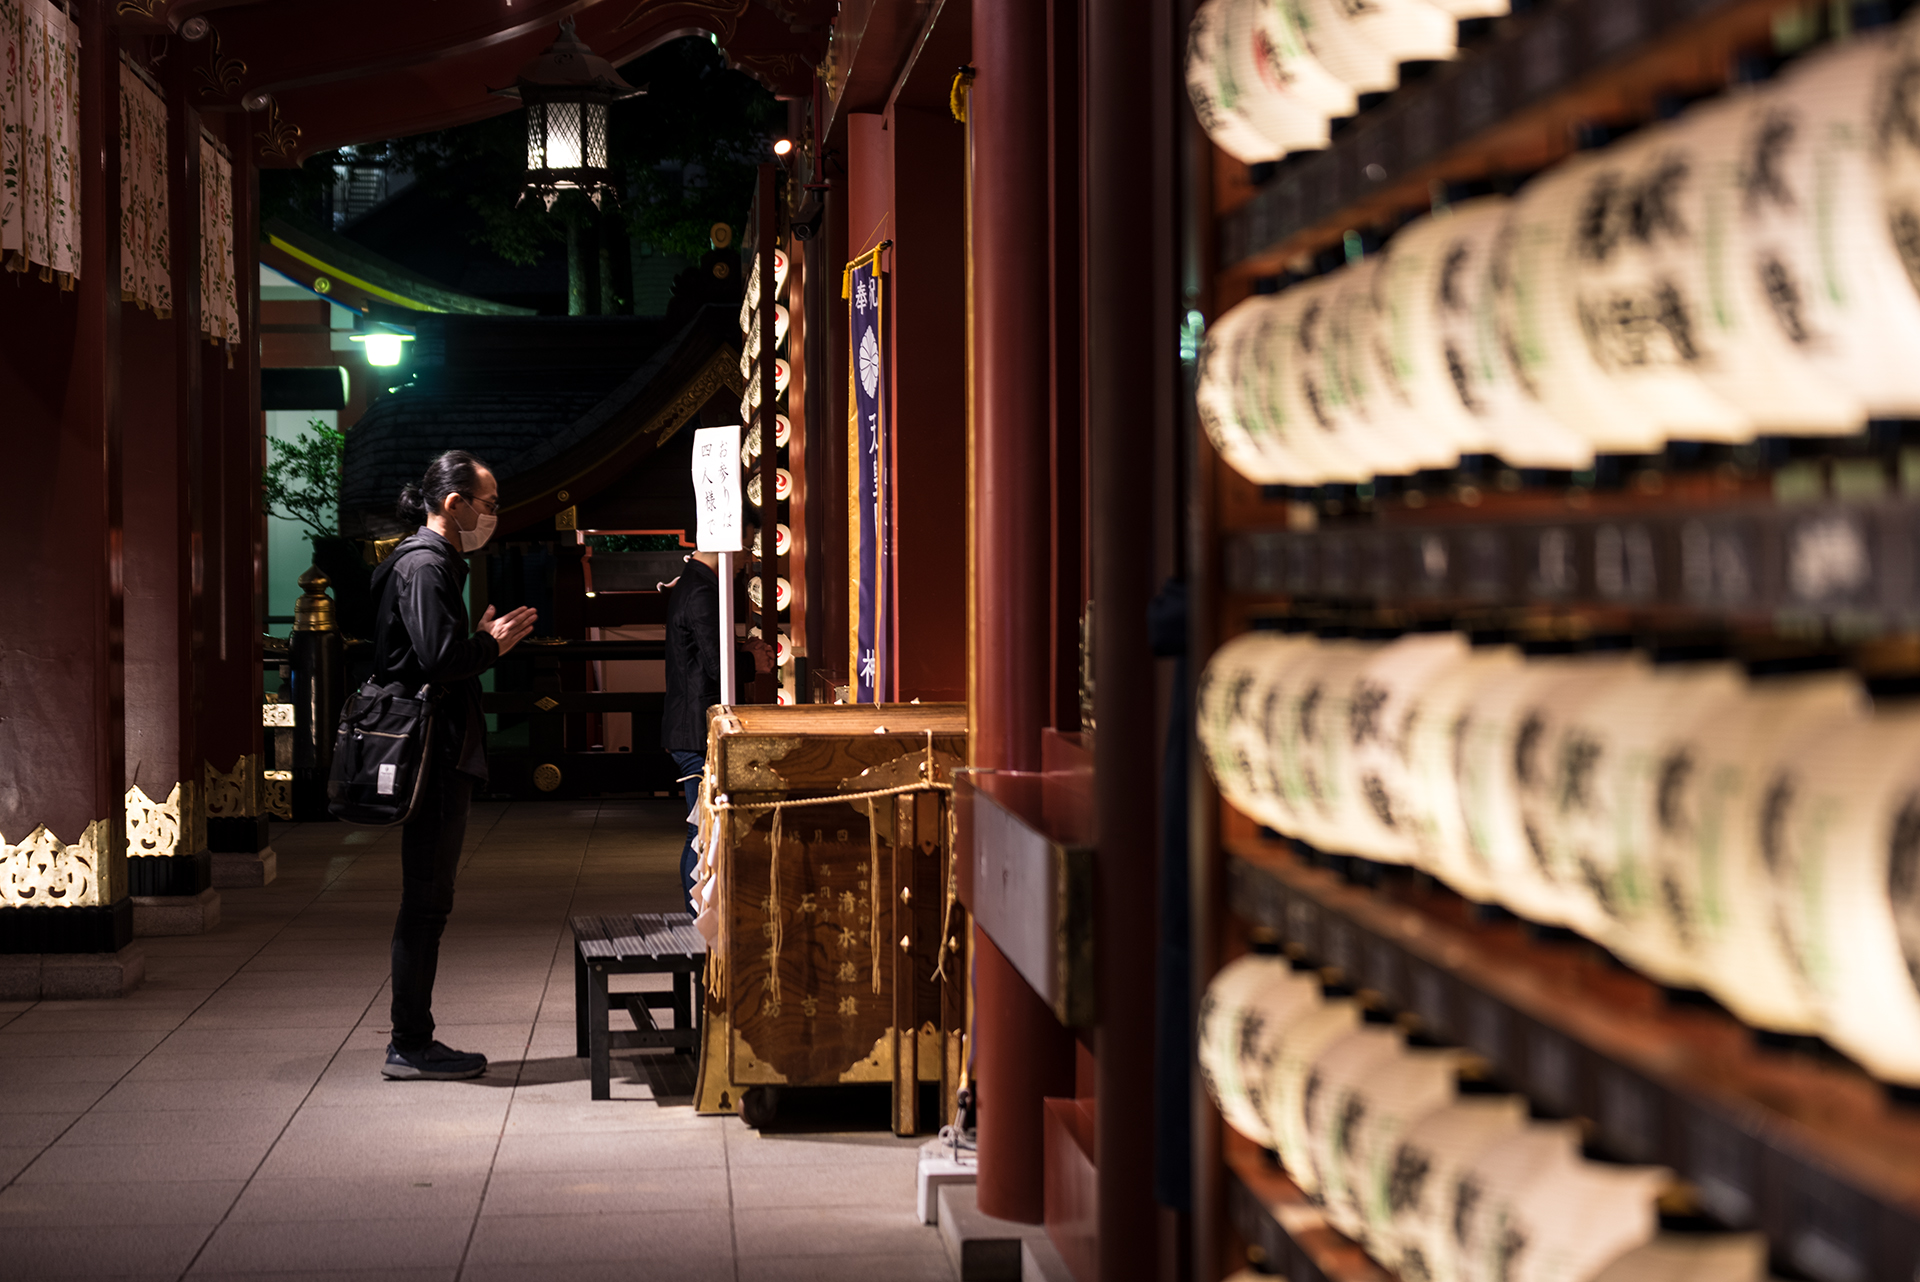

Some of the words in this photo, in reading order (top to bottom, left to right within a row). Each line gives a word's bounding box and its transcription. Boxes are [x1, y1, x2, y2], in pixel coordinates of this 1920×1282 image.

[855, 276, 878, 316] 奉祝
[702, 443, 716, 537] 四人様で
[718, 440, 732, 528] お参りは
